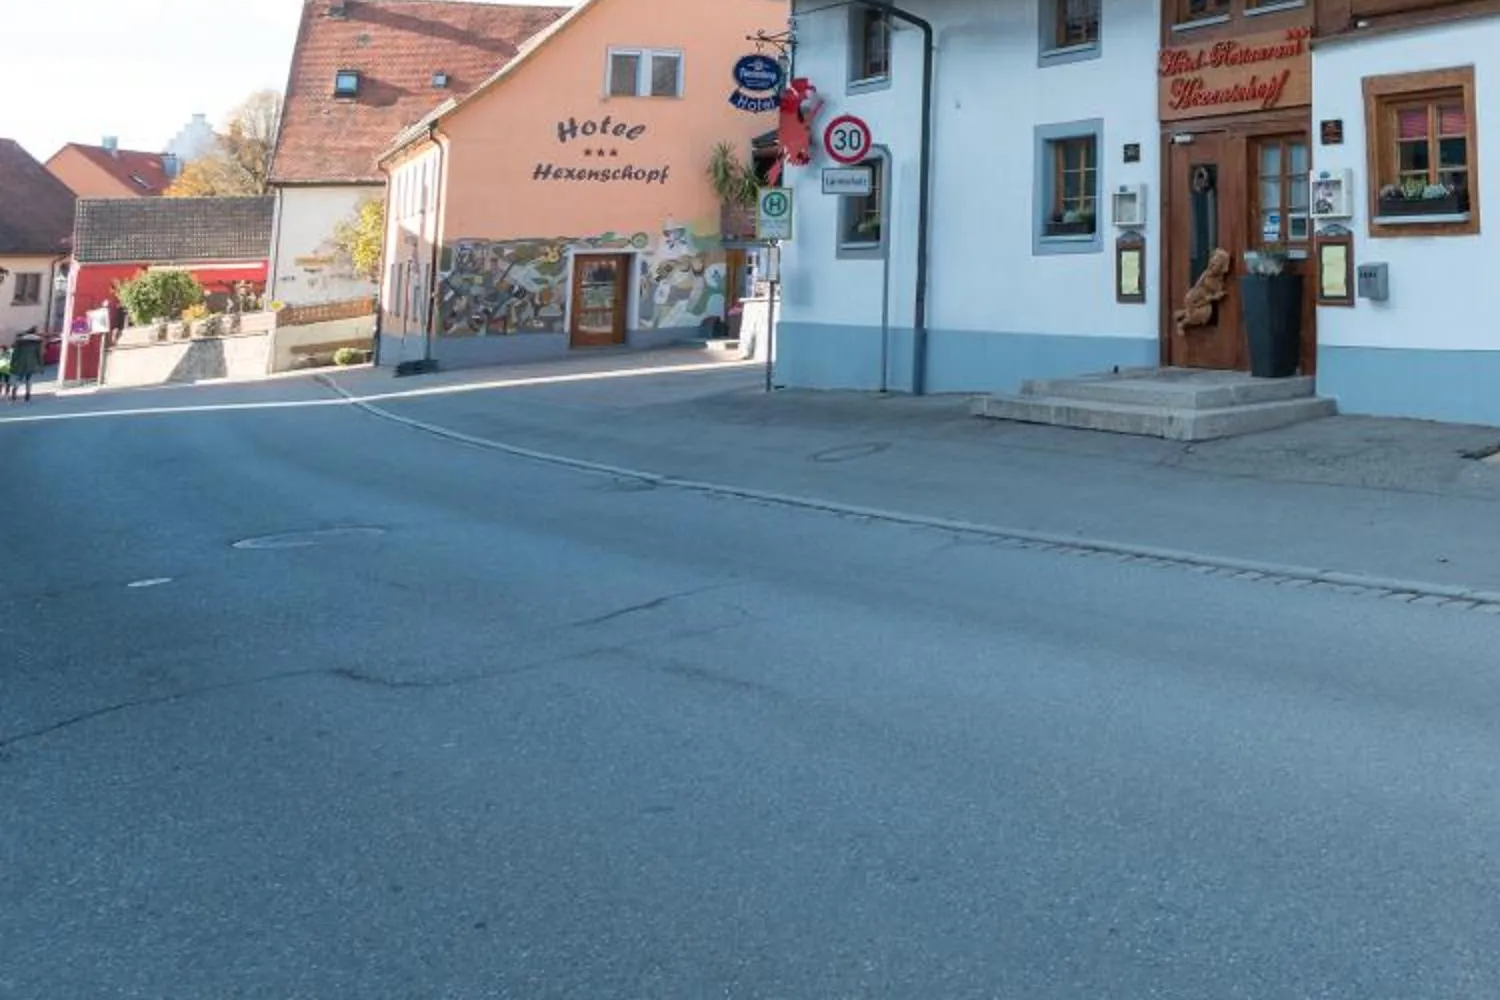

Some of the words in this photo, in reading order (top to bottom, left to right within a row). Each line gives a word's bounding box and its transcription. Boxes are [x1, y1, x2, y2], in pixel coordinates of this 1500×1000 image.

[737, 95, 776, 111] Hotel
[557, 115, 646, 143] Hotel
[833, 128, 862, 151] 30
[532, 163, 670, 185] Hexenschopf
